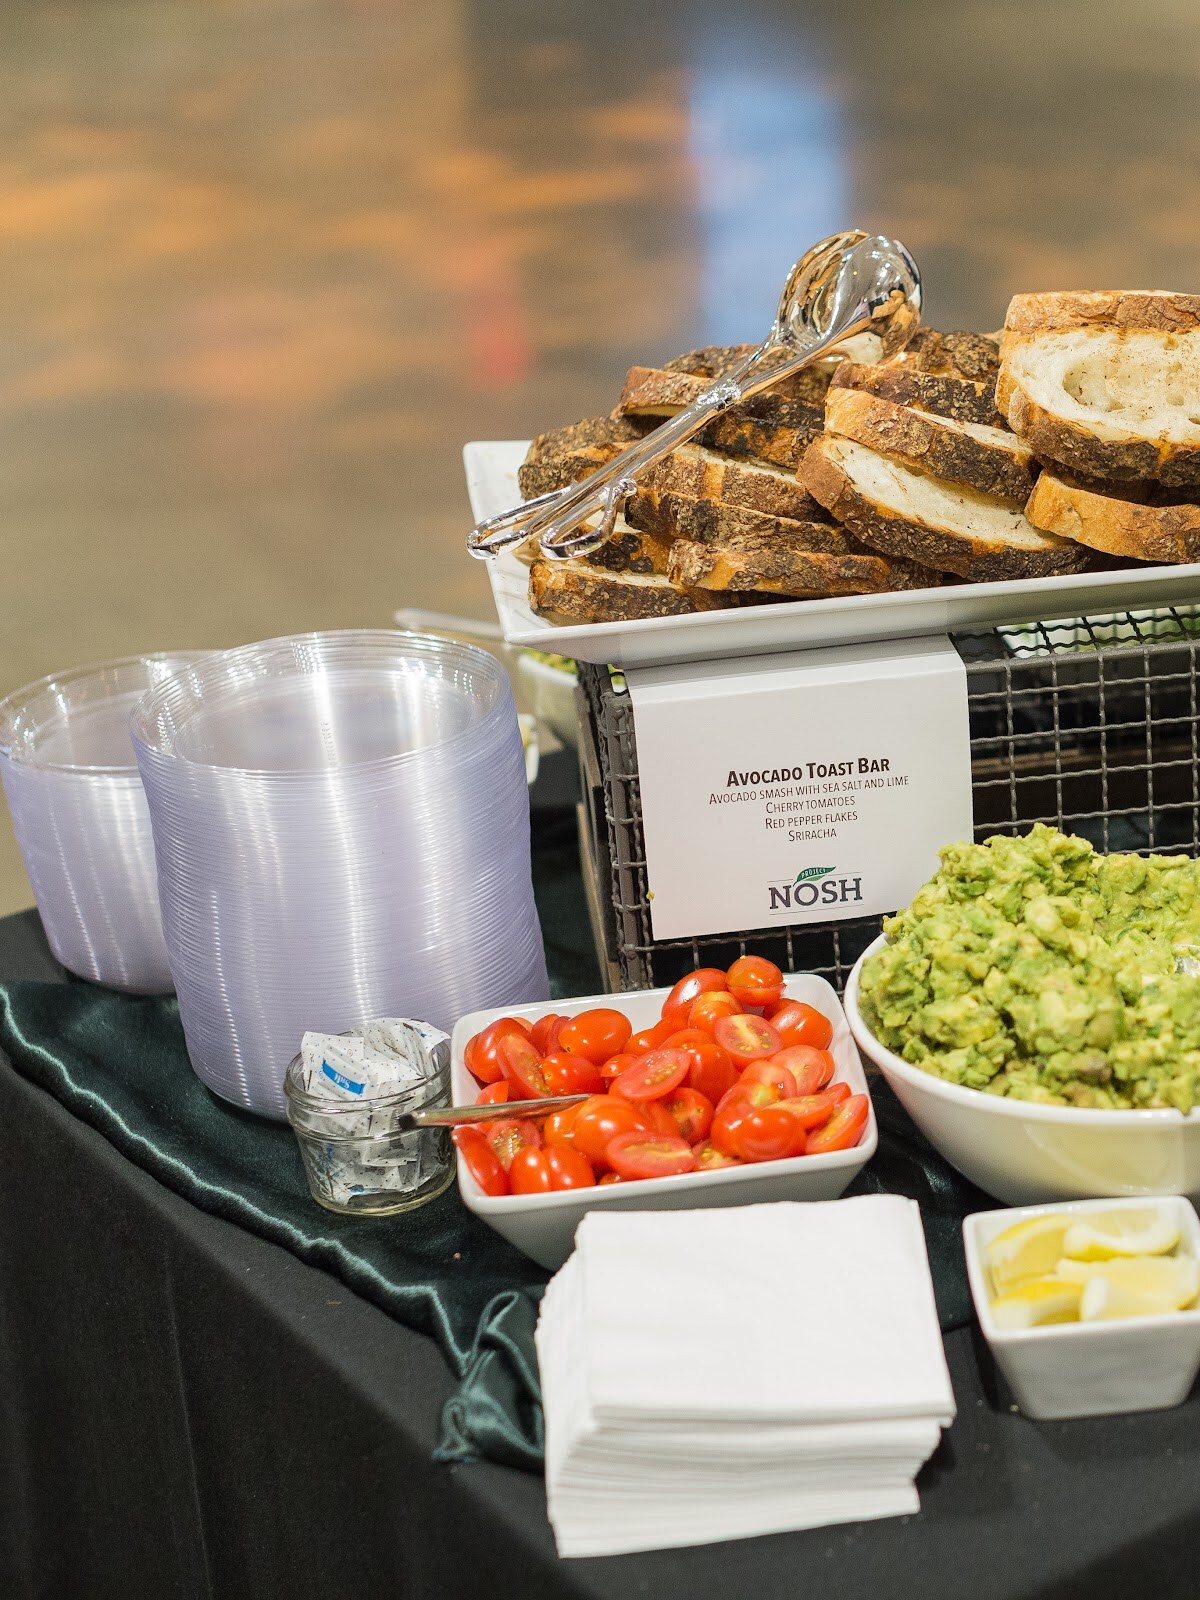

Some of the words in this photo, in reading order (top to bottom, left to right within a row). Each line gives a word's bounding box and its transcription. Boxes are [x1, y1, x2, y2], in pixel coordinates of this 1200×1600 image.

[727, 766, 803, 787] AVOCADO
[806, 762, 854, 779] TOAST
[858, 757, 890, 774] BAR
[709, 790, 757, 805] AVOCADO
[759, 787, 794, 800] SMASH
[796, 784, 820, 796] WITH
[822, 782, 840, 794] SEA
[842, 780, 862, 792] SALT
[864, 778, 885, 789] AND
[887, 776, 909, 787] LIME
[766, 801, 804, 814] CHERRY
[805, 796, 856, 810] TOMATOES
[765, 817, 785, 830] RED
[788, 814, 823, 827] PEPPER
[825, 811, 858, 823] FLAKES
[788, 828, 837, 842] SRIRACHA
[768, 878, 863, 909] NOSH
[334, 1072, 351, 1089] Salt
